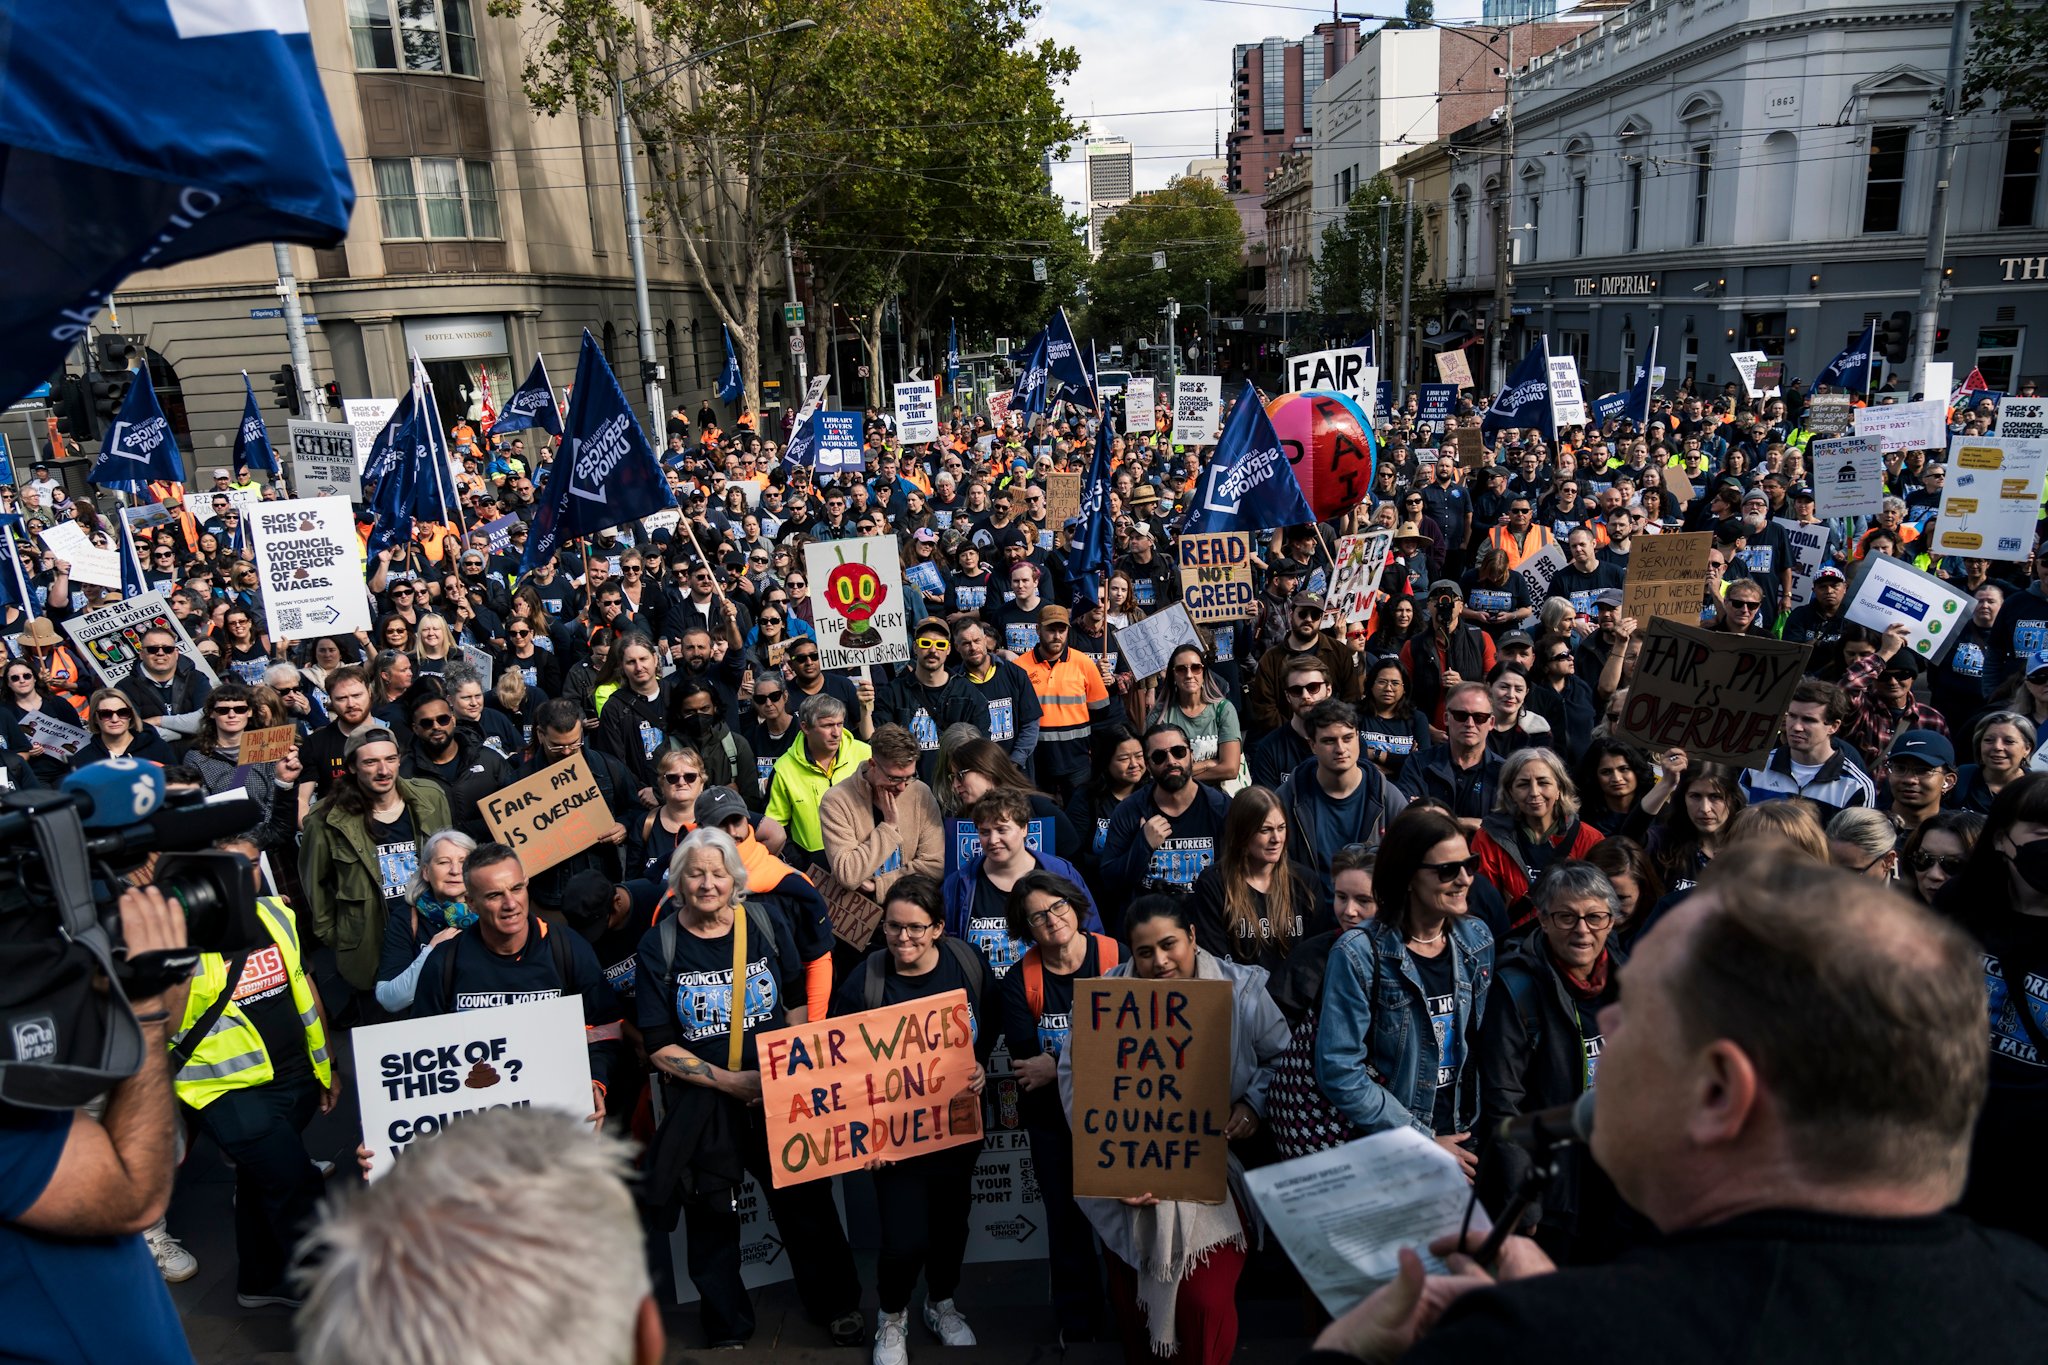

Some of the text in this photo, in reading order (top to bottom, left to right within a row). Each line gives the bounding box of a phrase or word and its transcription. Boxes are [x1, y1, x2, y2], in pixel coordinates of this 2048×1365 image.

[1771, 96, 1795, 108] 1863
[2000, 257, 2048, 281] TH
[1600, 275, 1651, 295] IMPERIAL
[424, 330, 493, 341] HOTEL WINDSOR
[1293, 353, 1363, 391] FAIR
[896, 386, 933, 396] VICTORIA.
[906, 411, 926, 420] STATE
[293, 427, 353, 437] COUNCIL WORKERS
[1890, 422, 1911, 430] PAY!
[296, 454, 354, 464] DESERVE FAIR PAY
[261, 511, 318, 526] SICK OF
[262, 520, 325, 535] THIS ?
[265, 537, 333, 552] COUNCIL
[1181, 535, 1248, 569] READ,
[1641, 537, 1699, 553] WE LOVE
[267, 545, 344, 562] WORKERS
[1636, 555, 1694, 568] SERVING
[270, 557, 335, 573] ARE SICK
[1534, 560, 1553, 583] THIS
[271, 571, 290, 583] OF
[1199, 566, 1234, 582] NOT
[1636, 569, 1656, 581] THE
[272, 577, 333, 592] WAGES.
[1633, 583, 1701, 600] BUT WE'RE
[1874, 574, 1924, 599] We build readers
[309, 595, 335, 603] SUPPORT
[1185, 581, 1252, 608] GREED
[83, 600, 134, 625] MERRI-BEK
[306, 610, 333, 618] SERVICES
[1628, 600, 1703, 617] NOT VOLUNTEERS
[1860, 598, 1884, 613] Support
[77, 603, 163, 641] COUNCIL WORKERS
[816, 612, 903, 635] THE VERY
[820, 642, 910, 668] HUNGRY LIBRARIAN
[1644, 634, 1801, 704] FAIR PAY
[1694, 679, 1723, 708] is
[35, 716, 53, 727] FAIR
[52, 723, 69, 732] PAY
[38, 726, 70, 741] RADICAL
[246, 728, 292, 746] FAIR WORK
[1361, 731, 1387, 743] COUNCIL
[247, 750, 265, 762] FAIR
[488, 763, 579, 825] FAIR PAY
[504, 829, 529, 849] IS
[533, 784, 600, 833] OVERDUE
[1175, 838, 1212, 850] WORKERS
[846, 892, 881, 923] PAY
[240, 972, 285, 995] FRONTLINE
[679, 972, 724, 986] COUNCIL
[459, 993, 509, 1009] COUNCIL
[1090, 991, 1193, 1031] FAIR
[19, 1025, 53, 1048] porta
[767, 1003, 970, 1080] FAIR WAGES
[380, 1037, 508, 1079] SICK OF
[1117, 1035, 1193, 1070] PAY
[1998, 1037, 2038, 1062] FAIR
[382, 1059, 523, 1102] THIS ?
[1113, 1074, 1181, 1101] FOR
[788, 1057, 946, 1124] ARE LONG
[1083, 1108, 1222, 1136] COUNCIL
[781, 1105, 943, 1173] OVERDUE!
[1098, 1139, 1200, 1170] STAFF
[973, 1163, 1011, 1176] SHOW
[976, 1178, 1012, 1189] YOUR
[985, 1223, 1026, 1232] SERVICES
[991, 1229, 1020, 1237] UNION
